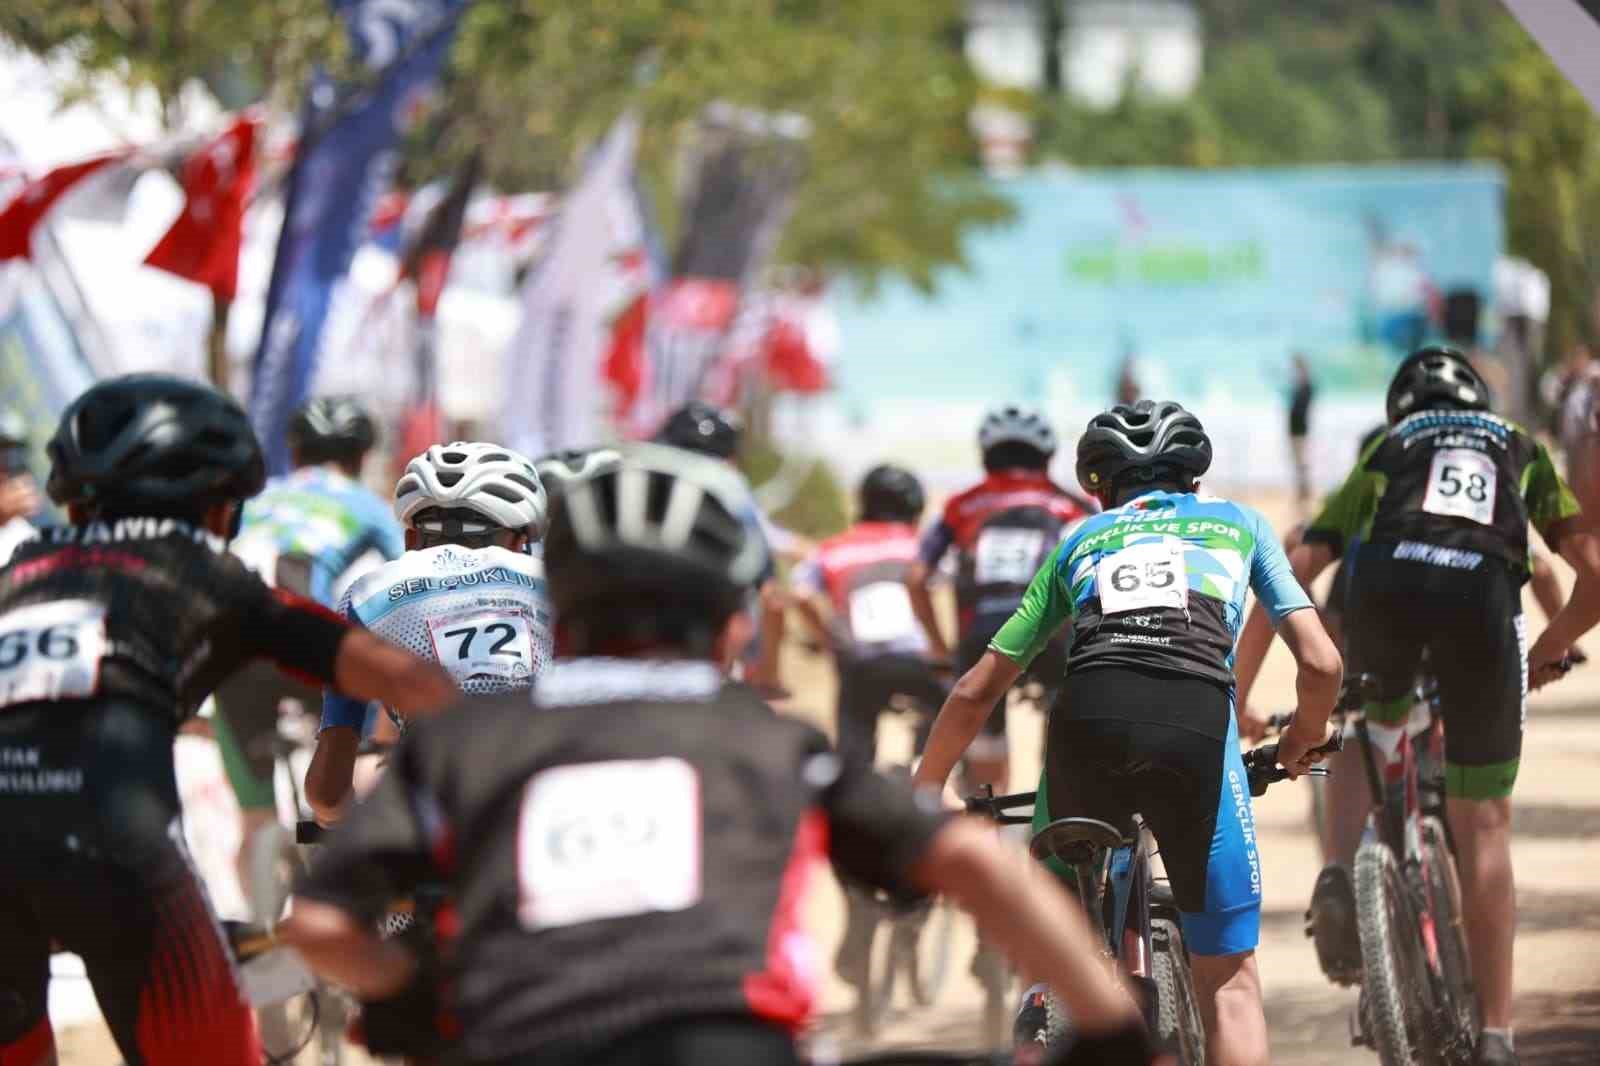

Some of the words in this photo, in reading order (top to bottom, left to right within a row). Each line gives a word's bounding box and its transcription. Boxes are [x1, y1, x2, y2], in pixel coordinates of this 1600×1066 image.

[1438, 465, 1488, 503] 58
[1152, 523, 1180, 534] VE
[1186, 522, 1242, 542] SPOR
[1110, 559, 1176, 592] 65
[443, 622, 523, 660] 72
[1246, 849, 1262, 895] SPOR
